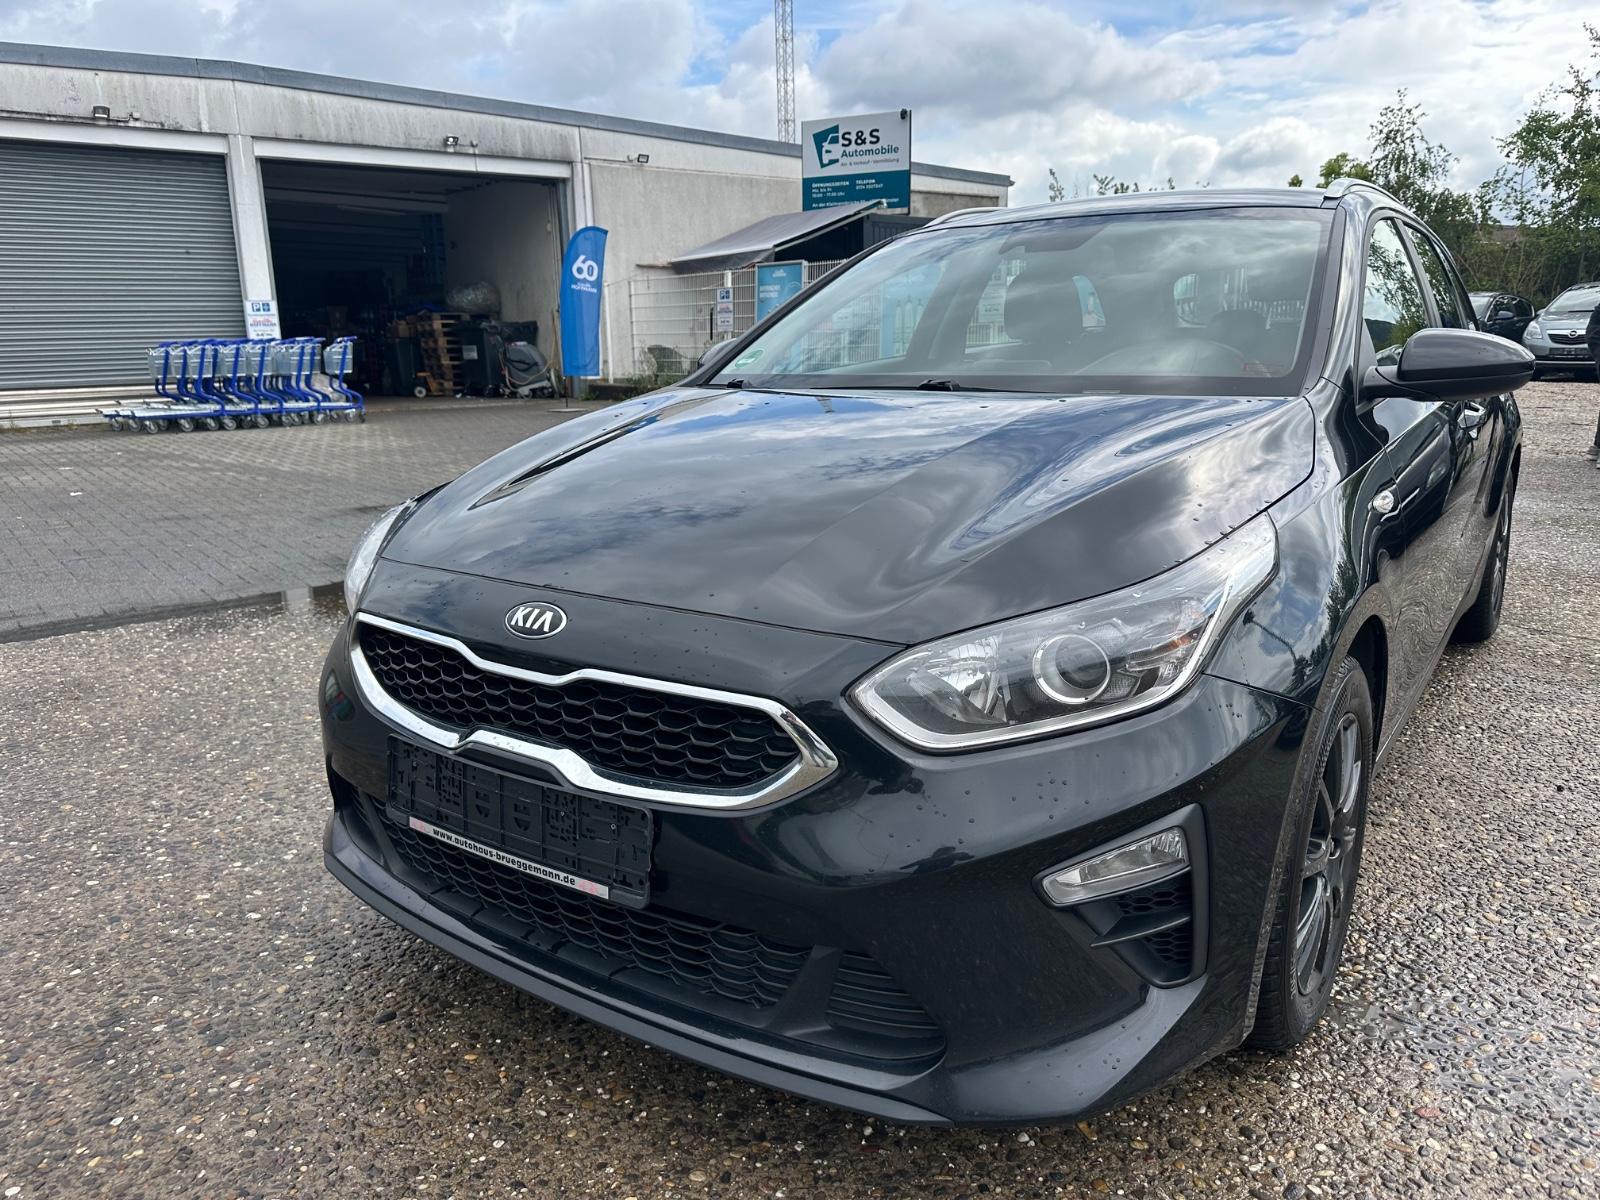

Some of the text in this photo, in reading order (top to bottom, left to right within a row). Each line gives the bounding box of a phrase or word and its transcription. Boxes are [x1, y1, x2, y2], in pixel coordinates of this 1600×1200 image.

[841, 128, 880, 147] S&S
[841, 144, 899, 158] Automobile
[571, 254, 599, 282] 60
[510, 606, 554, 632] KIA
[432, 827, 576, 886] www.autohaus-brueggemann.de
